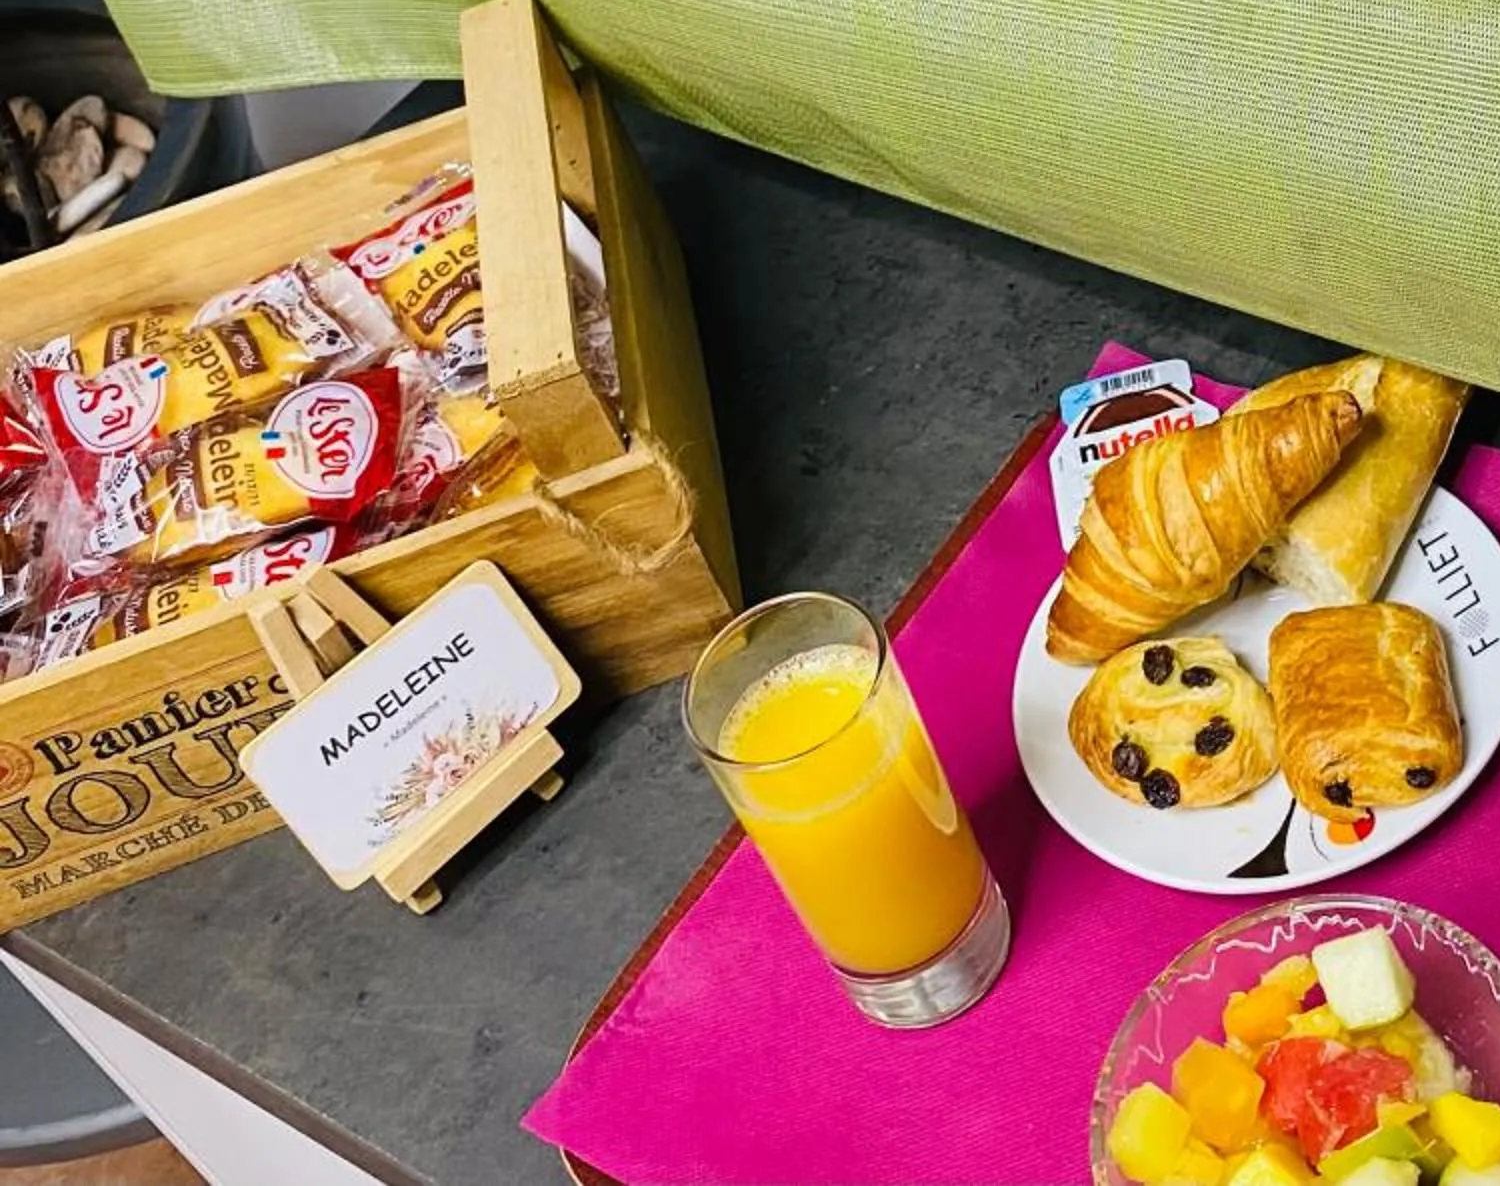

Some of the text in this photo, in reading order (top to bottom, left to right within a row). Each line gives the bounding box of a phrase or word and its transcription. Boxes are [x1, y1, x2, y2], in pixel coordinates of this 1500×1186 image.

[306, 395, 352, 420] Le
[1078, 414, 1196, 463] nutella
[307, 417, 357, 485] Ster
[34, 675, 260, 776] Panier
[318, 631, 476, 767] MADELEINE
